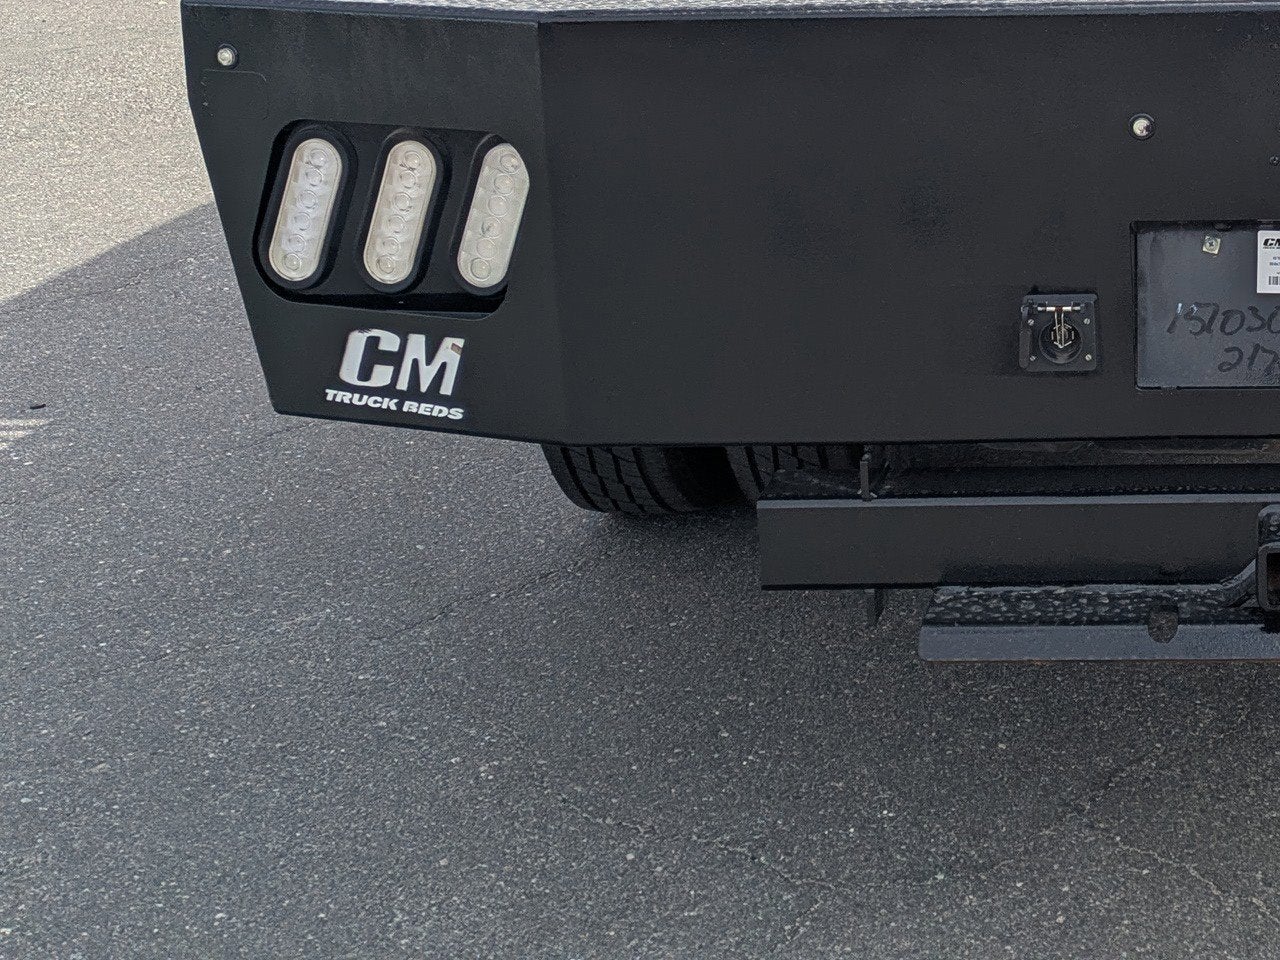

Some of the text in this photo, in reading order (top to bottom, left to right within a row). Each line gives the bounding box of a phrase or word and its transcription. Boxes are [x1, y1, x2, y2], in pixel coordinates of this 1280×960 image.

[339, 328, 465, 396] CM
[325, 389, 465, 420] TRUCK BEDS
